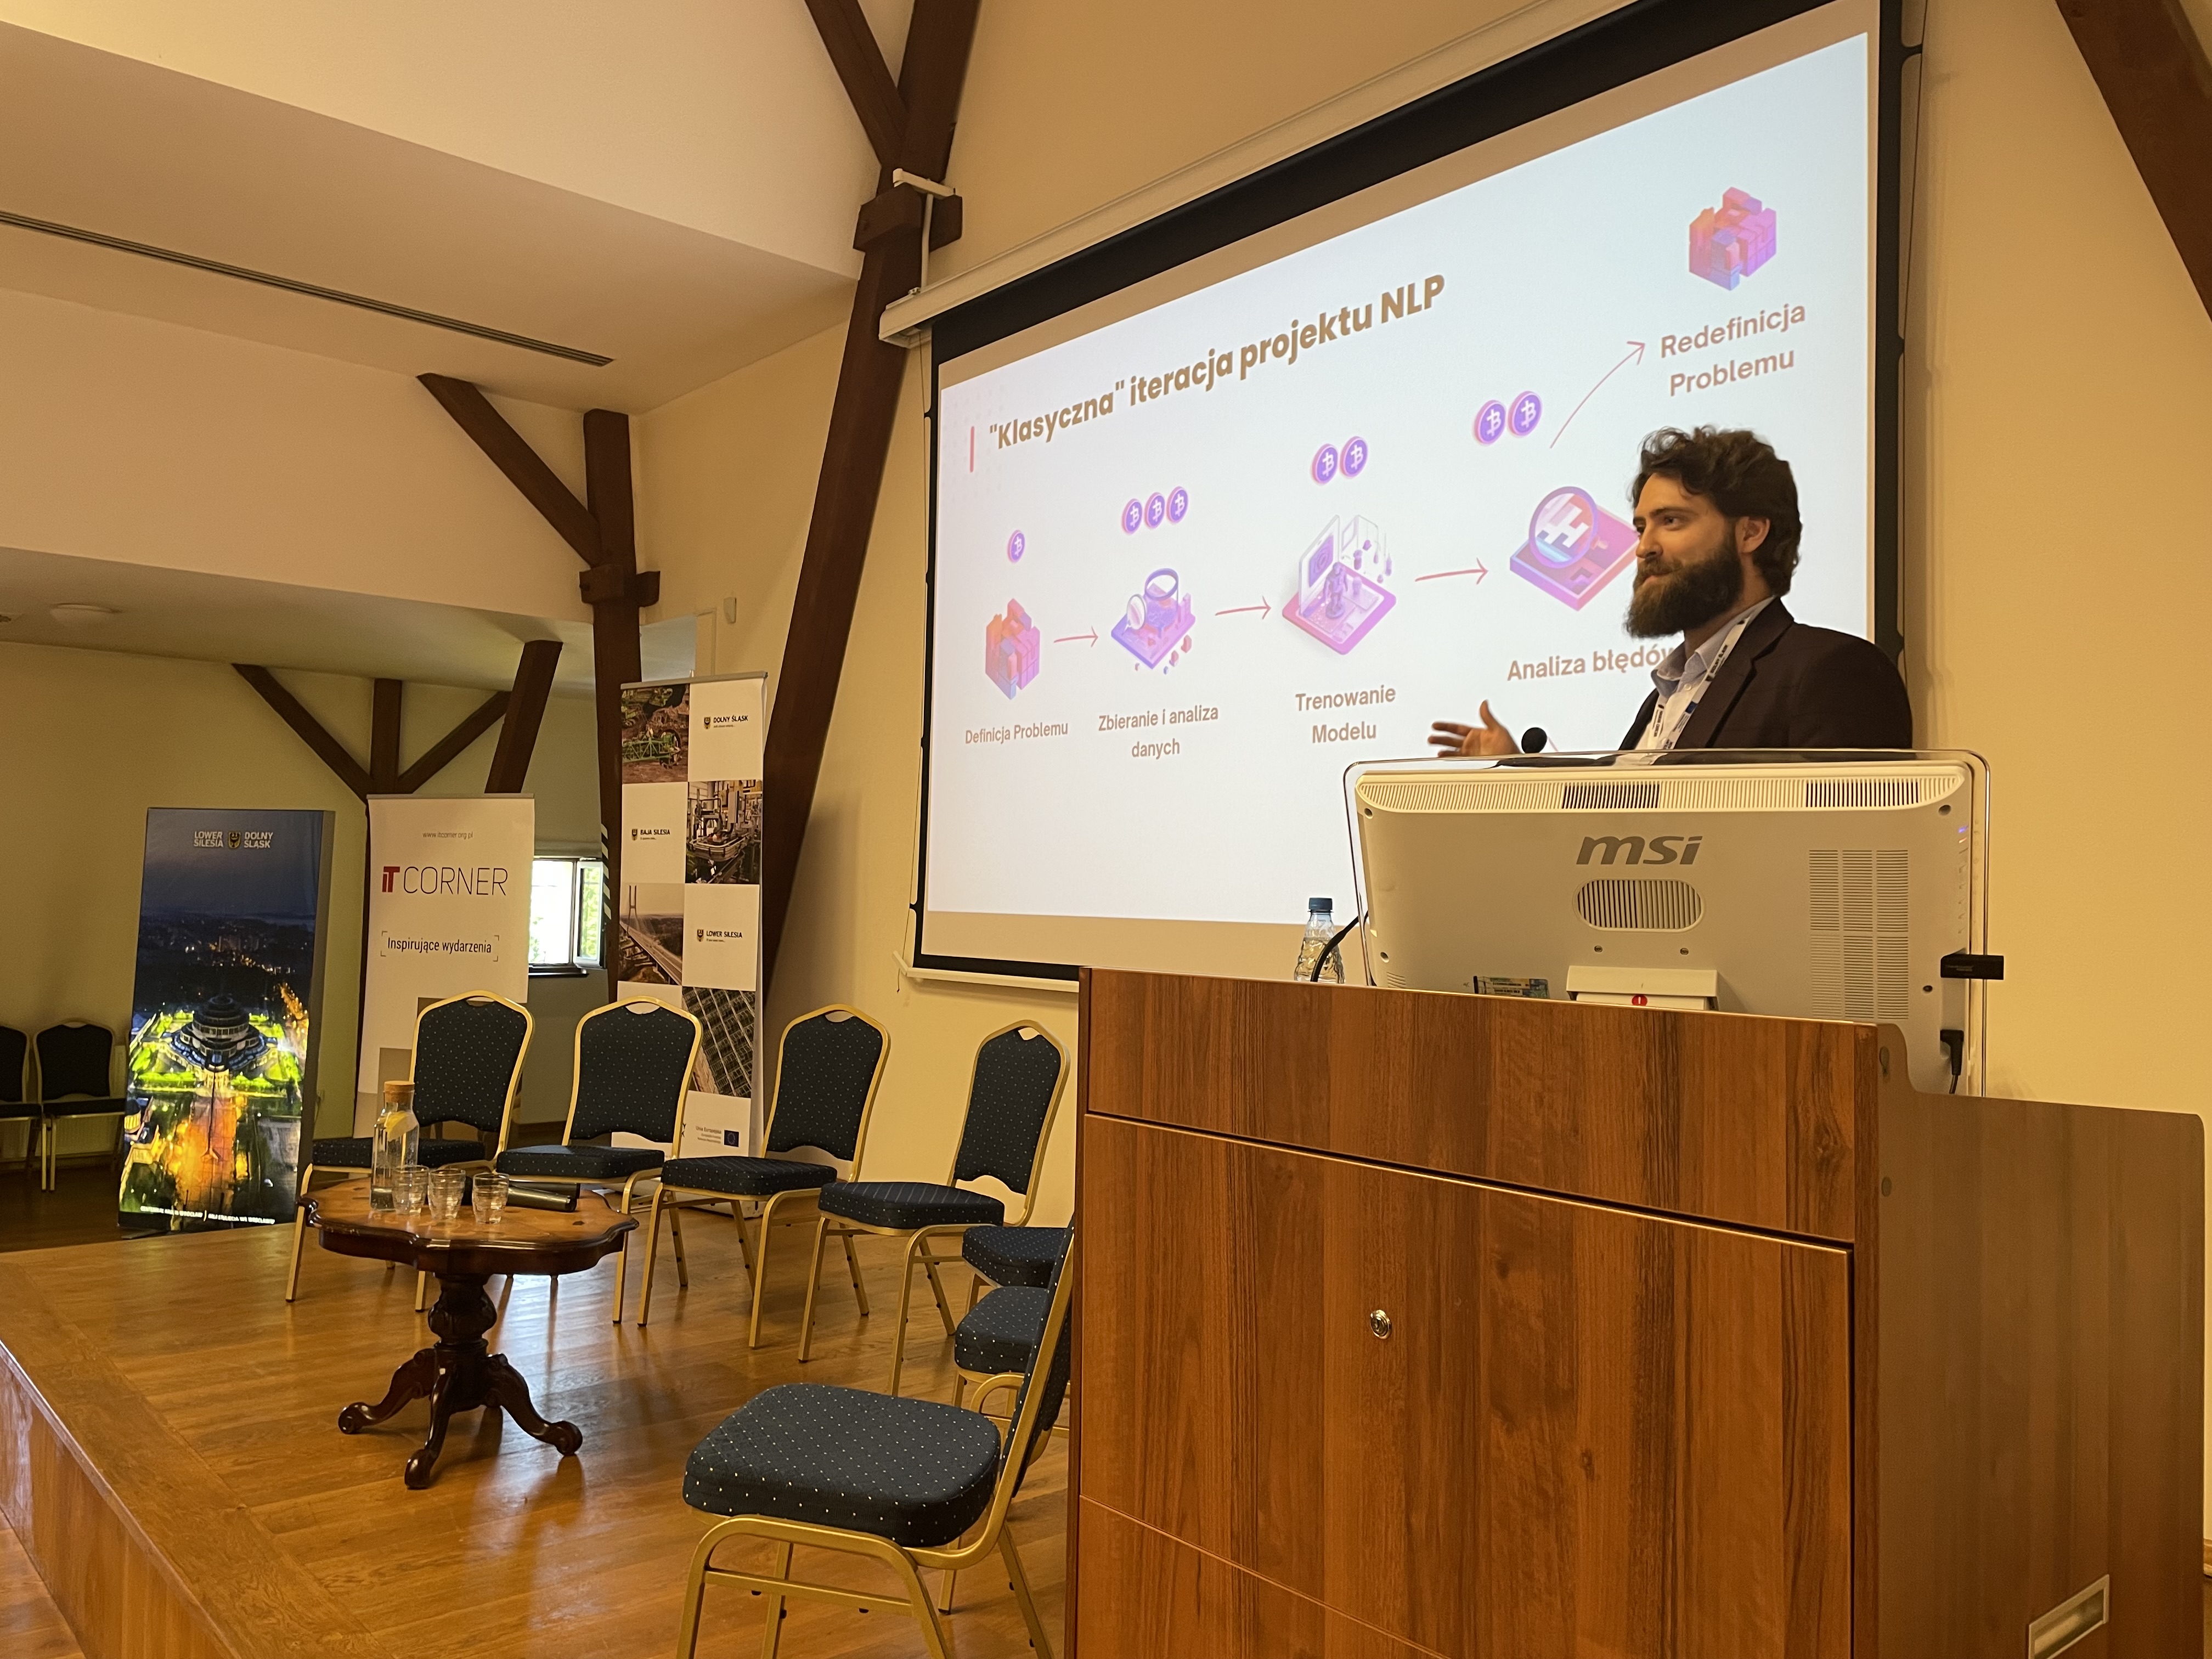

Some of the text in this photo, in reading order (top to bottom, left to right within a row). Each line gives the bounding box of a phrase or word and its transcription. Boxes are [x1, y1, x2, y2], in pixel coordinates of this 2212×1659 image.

[1661, 303, 1805, 358] Redefinicja
[989, 274, 1445, 449] "Klasyczna" iteracja projektu NLP
[1670, 349, 1795, 397] Problemu
[1506, 655, 1586, 681] Analiza
[1295, 684, 1396, 712] Trenowanie
[1098, 704, 1219, 731] Zbieranie i analiza
[965, 722, 1068, 744] Definicja Problemu
[1312, 721, 1376, 743] Modelu
[1131, 738, 1180, 760] danych
[194, 831, 223, 839] LOWER
[194, 839, 223, 848] SILESIA
[403, 866, 508, 896] CORNER
[387, 937, 492, 955] Inspirujące wydarzenia
